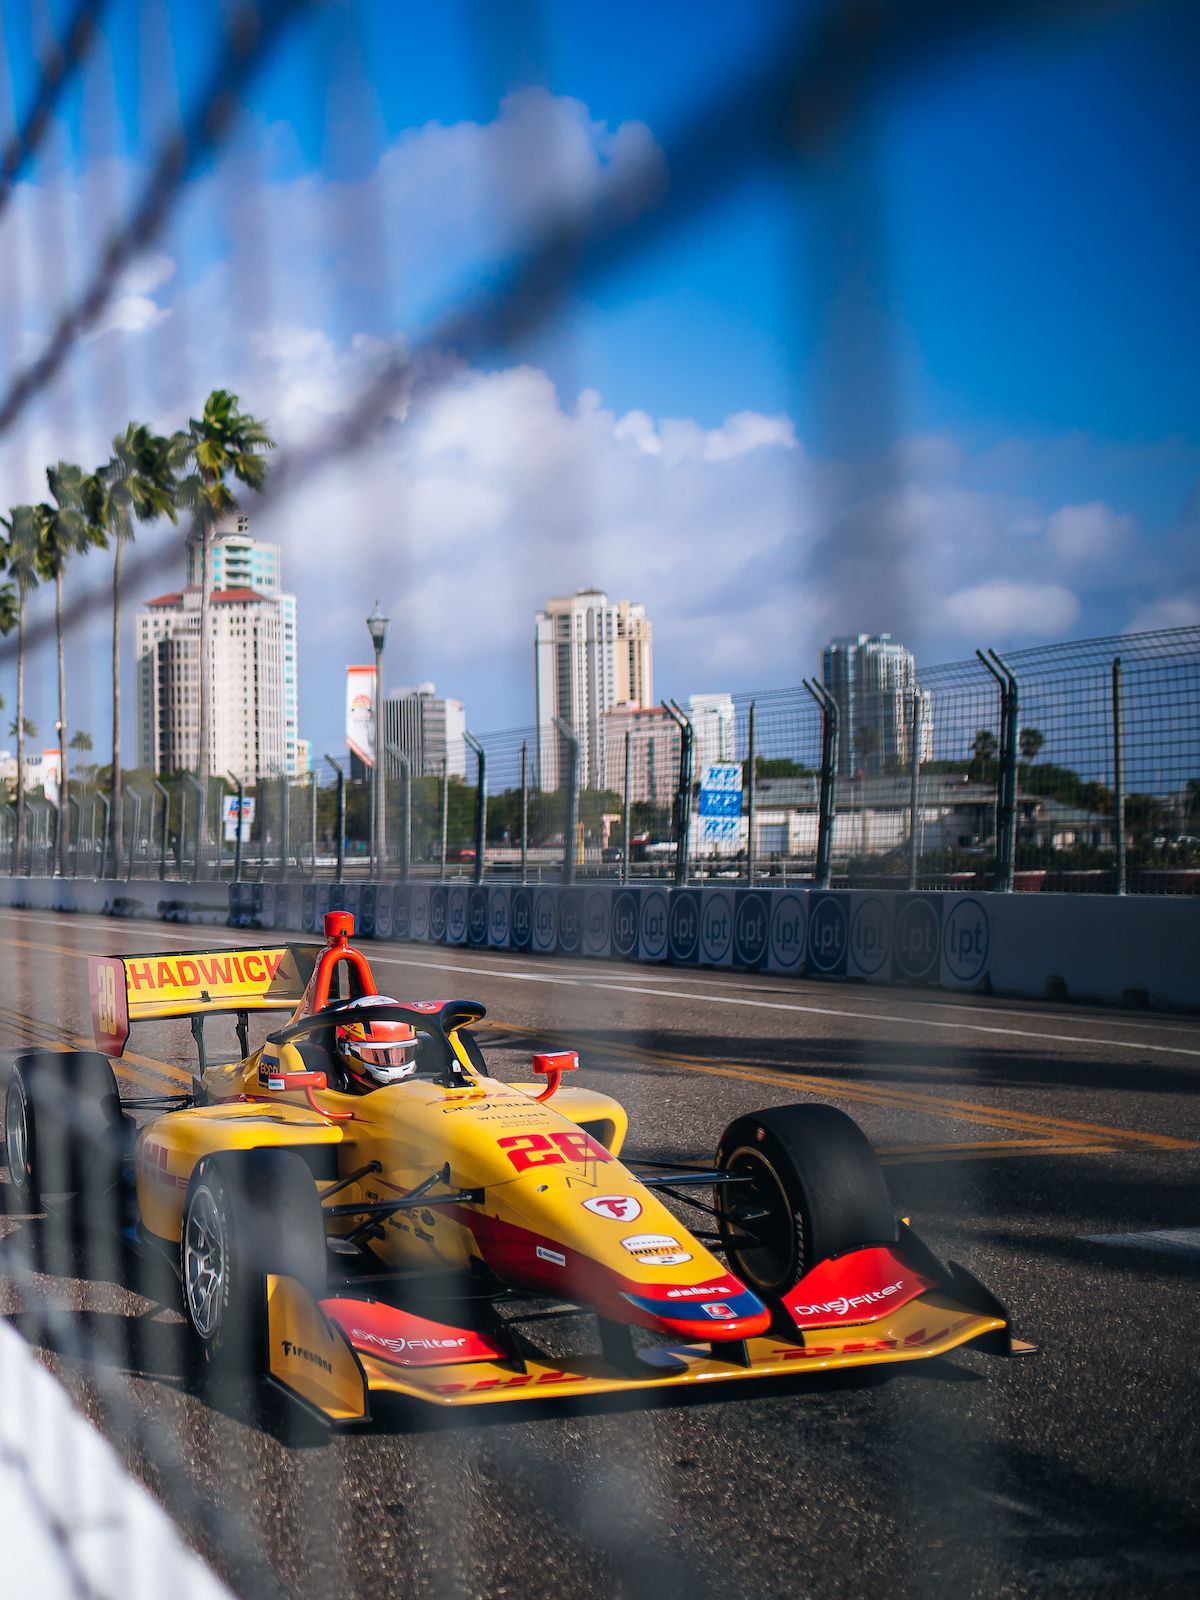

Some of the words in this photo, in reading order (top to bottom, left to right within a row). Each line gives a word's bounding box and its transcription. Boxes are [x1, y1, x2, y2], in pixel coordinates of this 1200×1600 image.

[535, 909, 552, 935] lpt
[615, 911, 634, 939] lpt
[645, 911, 664, 940] lpt
[674, 911, 695, 944] lpt
[706, 912, 728, 946] lpt
[739, 912, 763, 948] lpt
[776, 914, 800, 950] lpt
[814, 916, 841, 955] lpt
[857, 917, 886, 957] lpt
[951, 919, 983, 963] lpt
[126, 953, 292, 990] HADWICK
[97, 964, 118, 1036] 28
[477, 1113, 547, 1121] WILLIAMS
[496, 1132, 614, 1173] 28
[793, 1210, 805, 1286] Fireston
[666, 1286, 731, 1298] dallara
[795, 1280, 904, 1315] DNSFilter
[281, 1341, 333, 1376] Firestone
